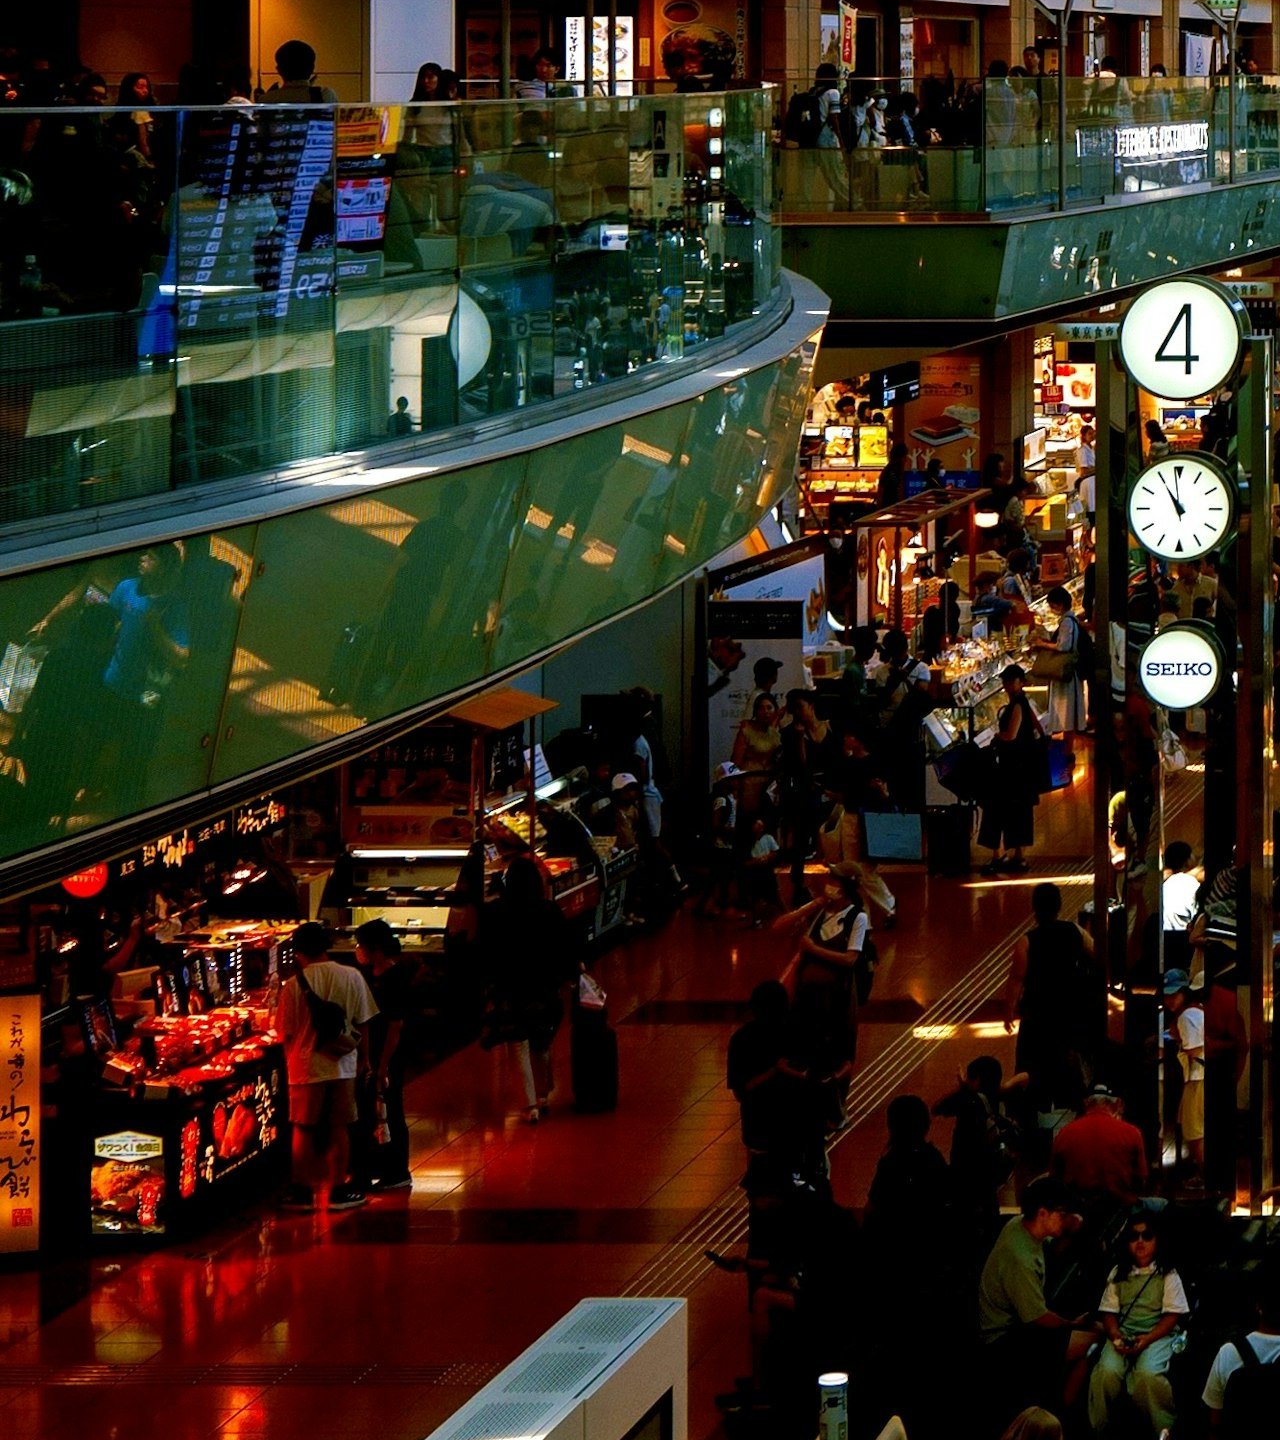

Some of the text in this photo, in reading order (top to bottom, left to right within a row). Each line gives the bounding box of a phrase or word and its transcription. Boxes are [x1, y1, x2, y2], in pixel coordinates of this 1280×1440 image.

[474, 204, 523, 235] 17
[1155, 303, 1200, 375] 4
[1145, 662, 1212, 677] SEIKO
